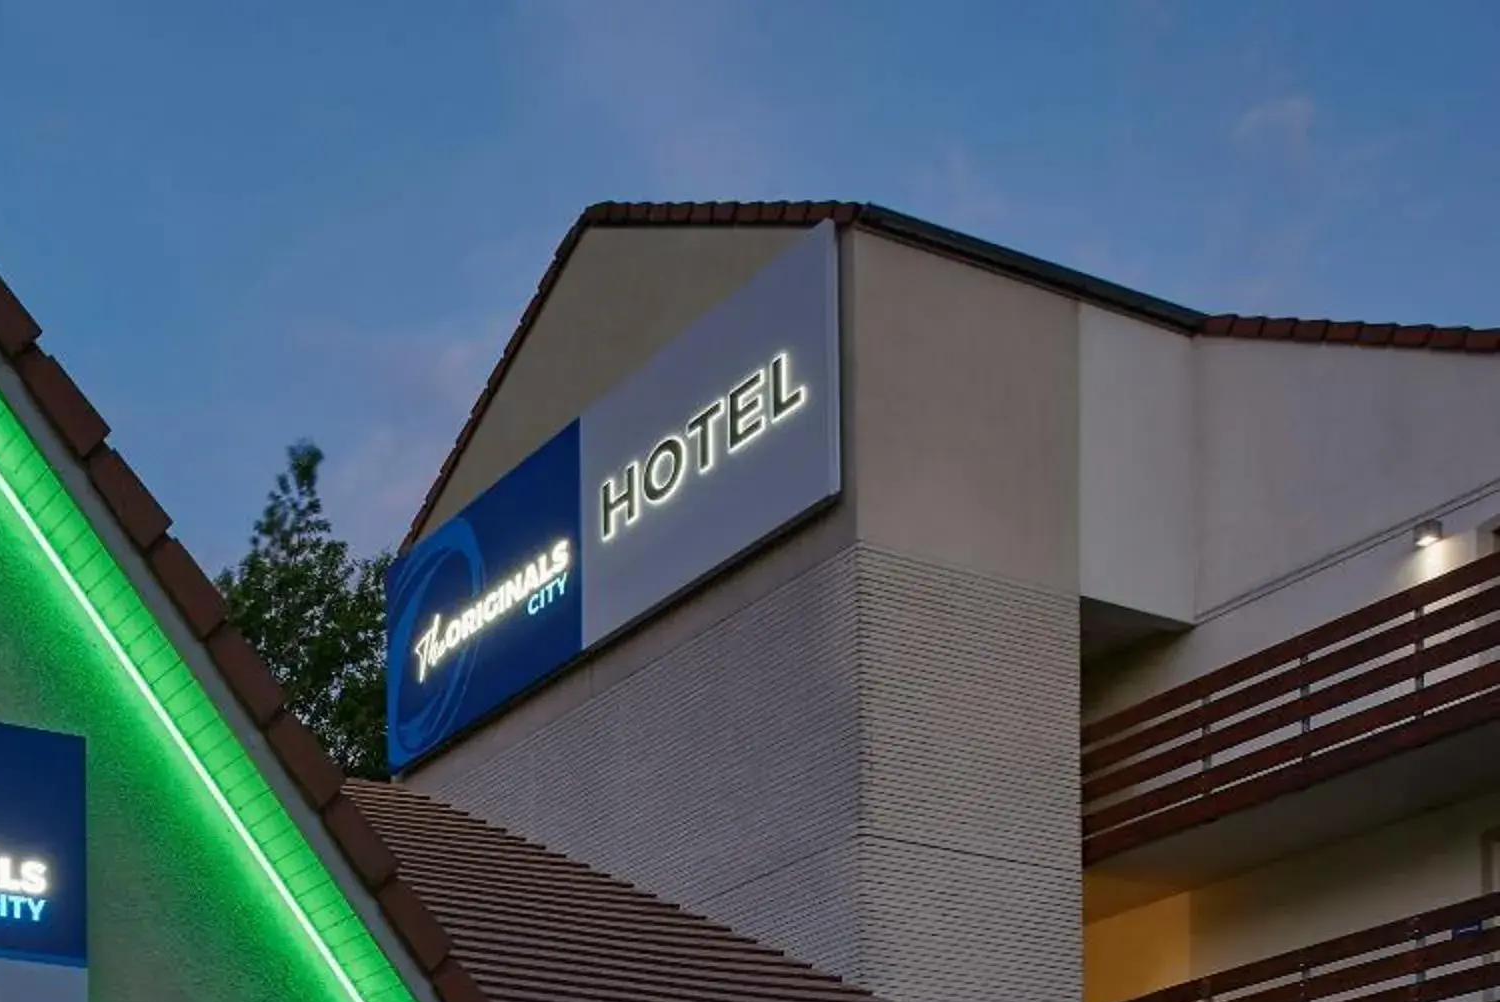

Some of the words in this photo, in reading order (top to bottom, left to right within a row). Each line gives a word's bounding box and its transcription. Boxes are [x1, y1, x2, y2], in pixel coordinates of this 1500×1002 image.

[599, 351, 808, 542] HOTEL
[446, 540, 570, 649] ORIGINALS
[527, 573, 568, 616] CITY
